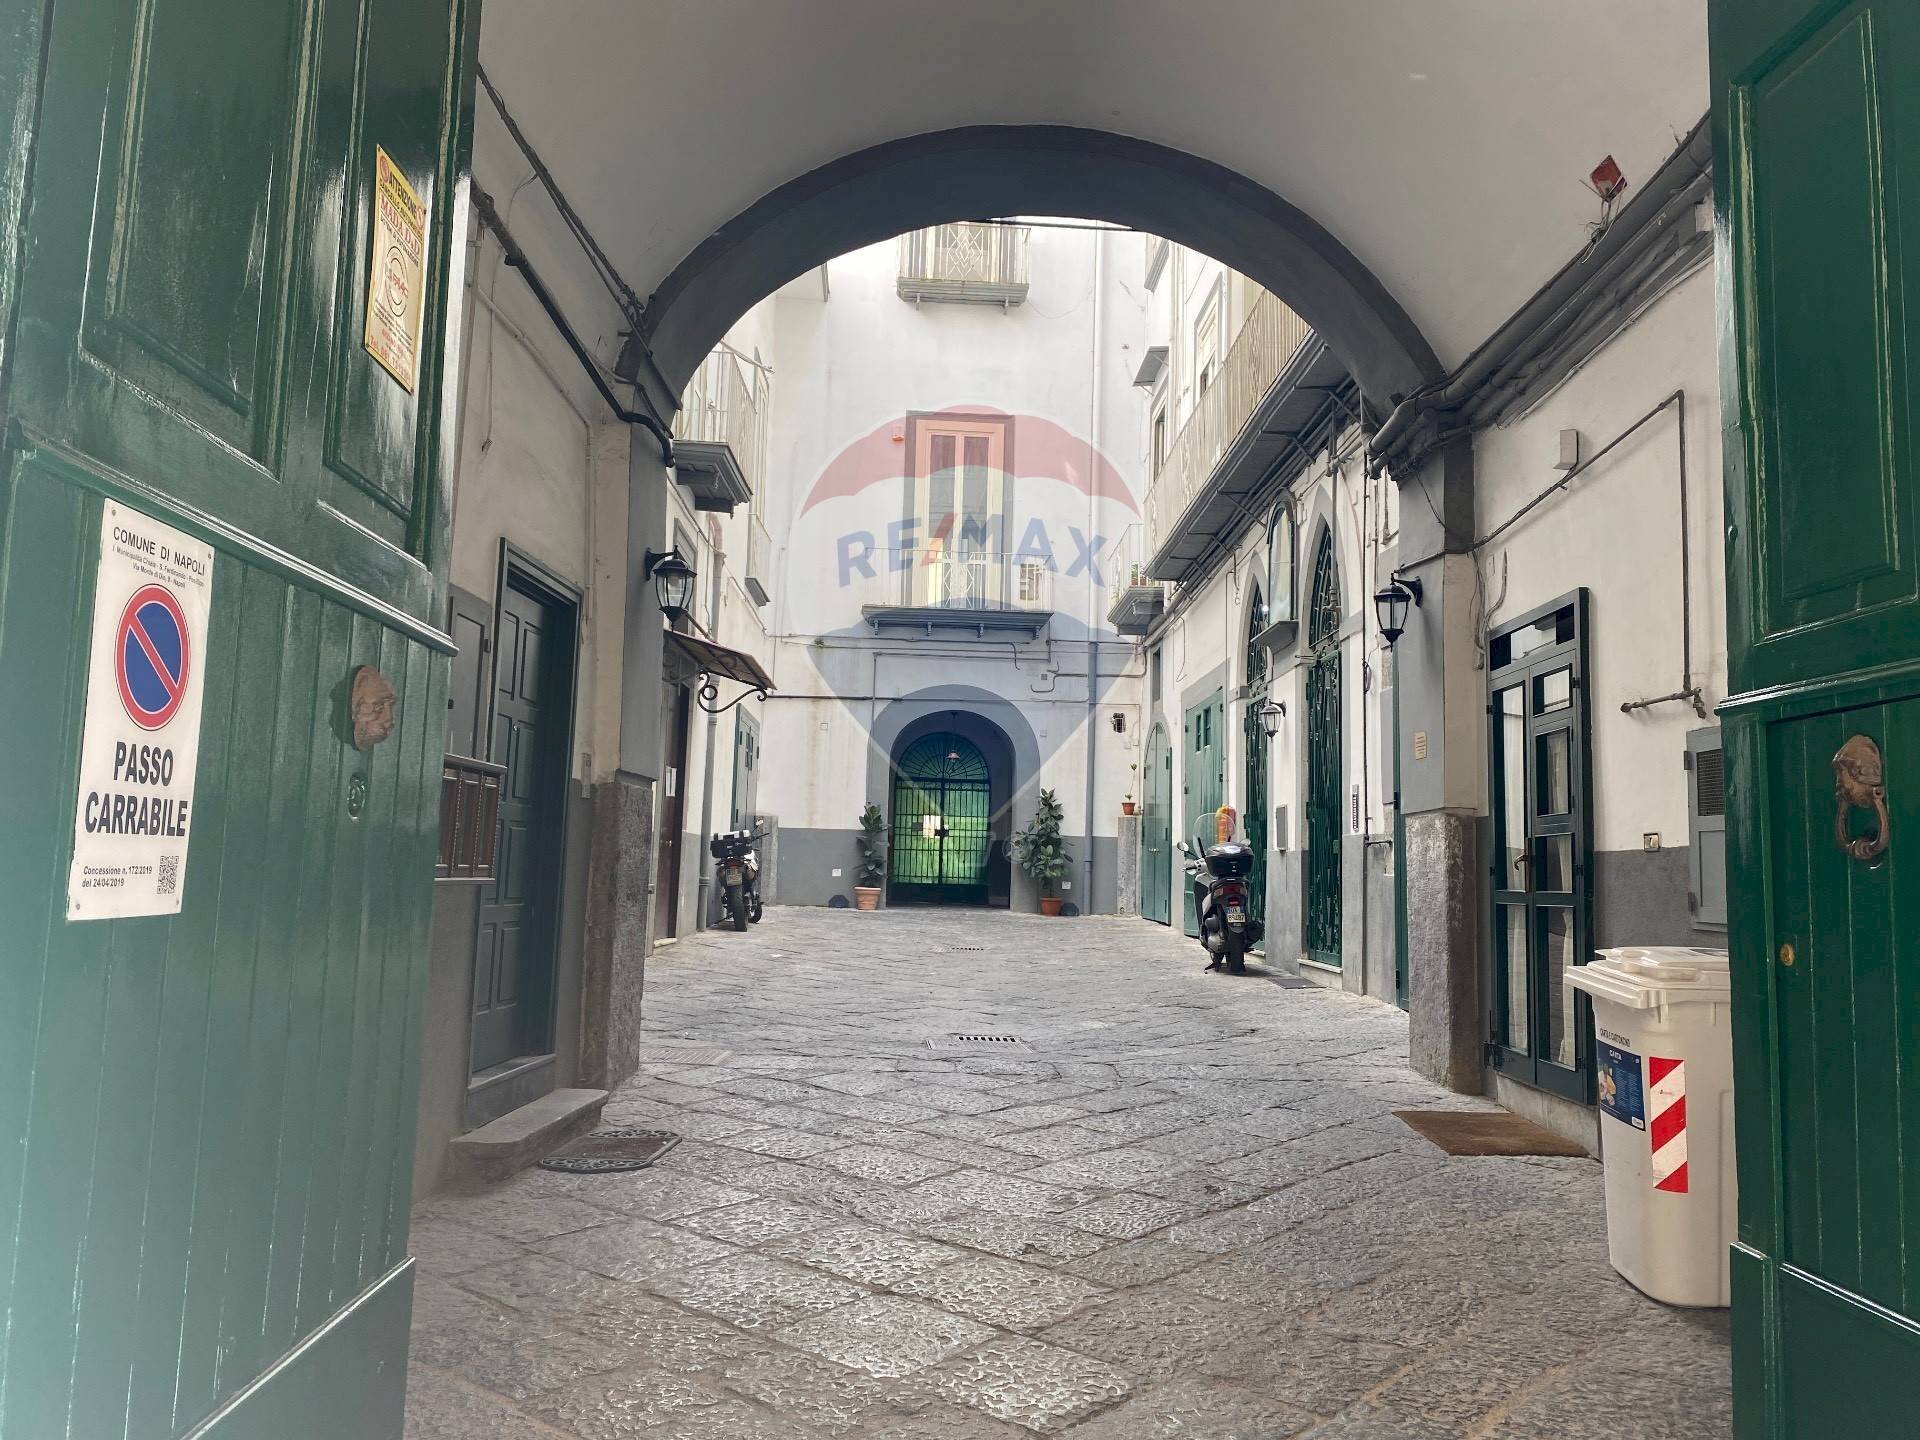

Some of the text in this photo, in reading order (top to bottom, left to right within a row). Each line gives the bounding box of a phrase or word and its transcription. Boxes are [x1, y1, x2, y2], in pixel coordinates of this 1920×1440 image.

[389, 171, 417, 219] ATTENZIONE
[113, 526, 206, 577] COMUNE DI NAPOLI
[113, 741, 174, 787] PASSO
[84, 791, 188, 837] CARRABILE
[81, 878, 92, 888] del
[83, 865, 121, 875] Concessione
